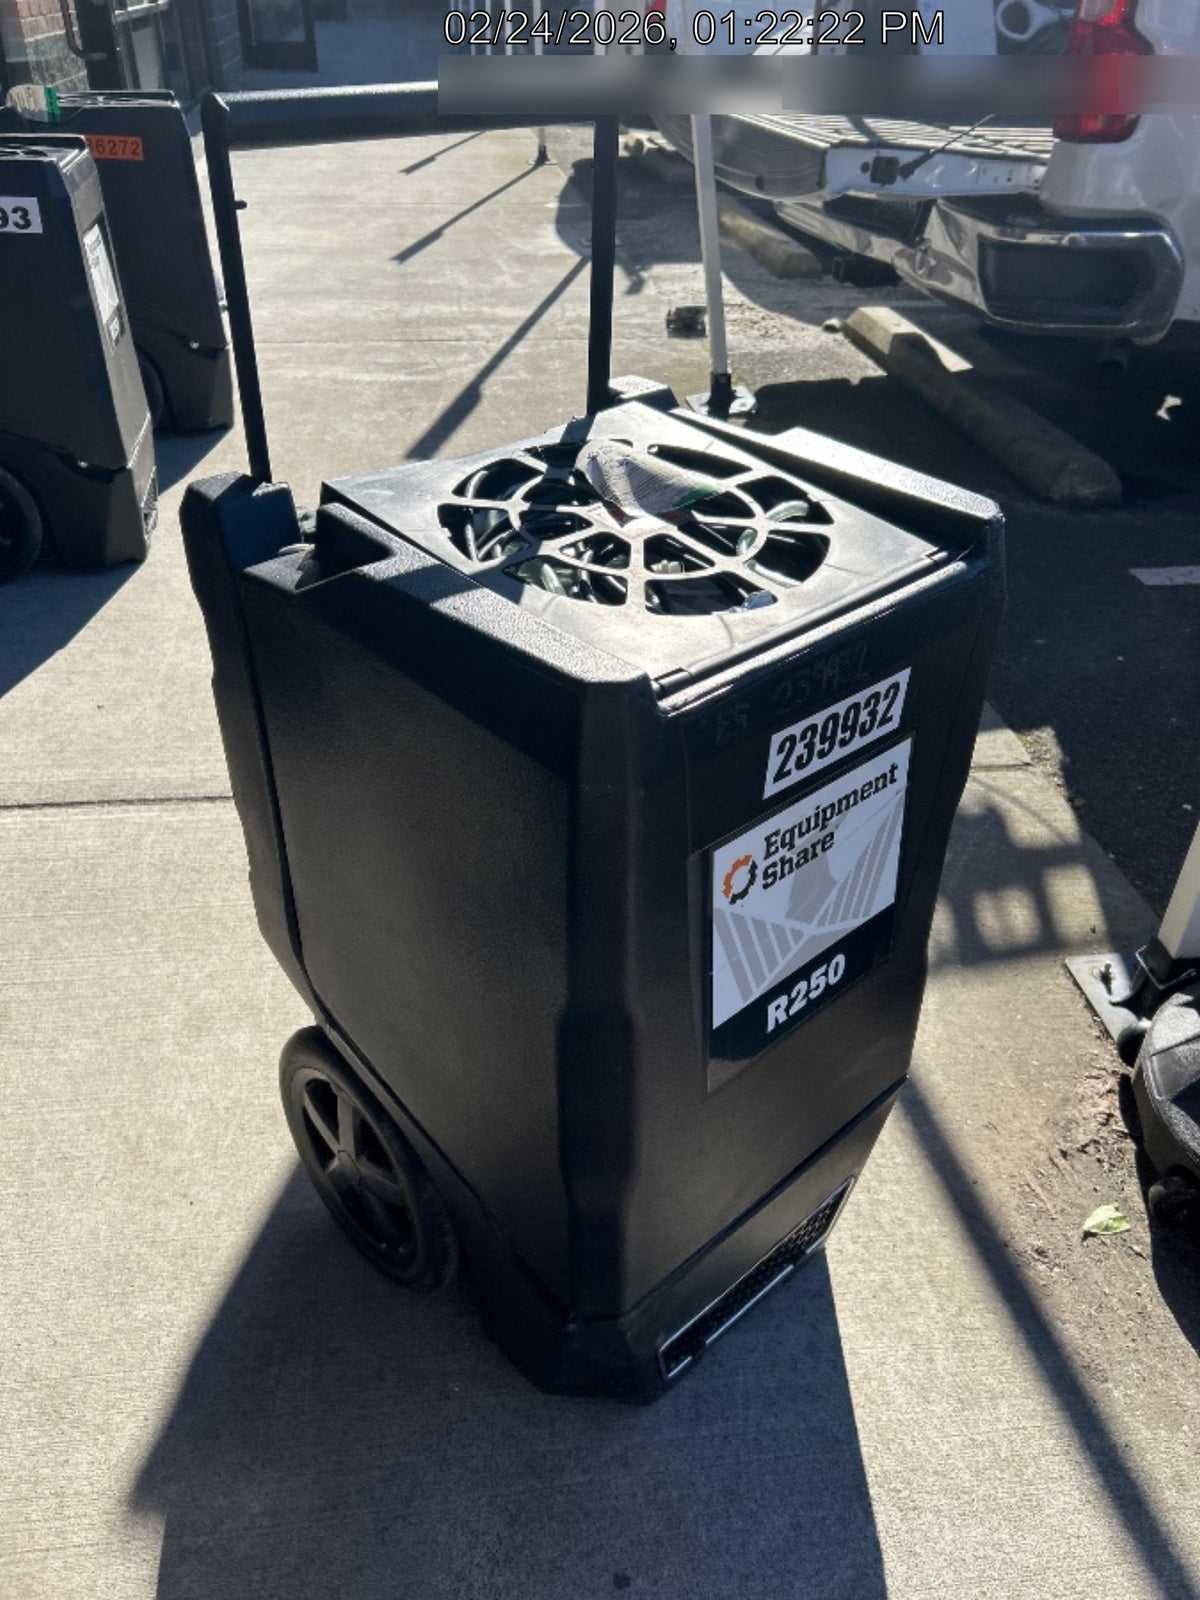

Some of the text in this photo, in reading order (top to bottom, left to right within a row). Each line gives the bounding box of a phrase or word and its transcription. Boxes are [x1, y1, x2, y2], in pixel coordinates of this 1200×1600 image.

[773, 682, 900, 784] 239932
[763, 762, 899, 860] Equipment
[763, 830, 835, 891] Share
[766, 953, 846, 1034] R250
